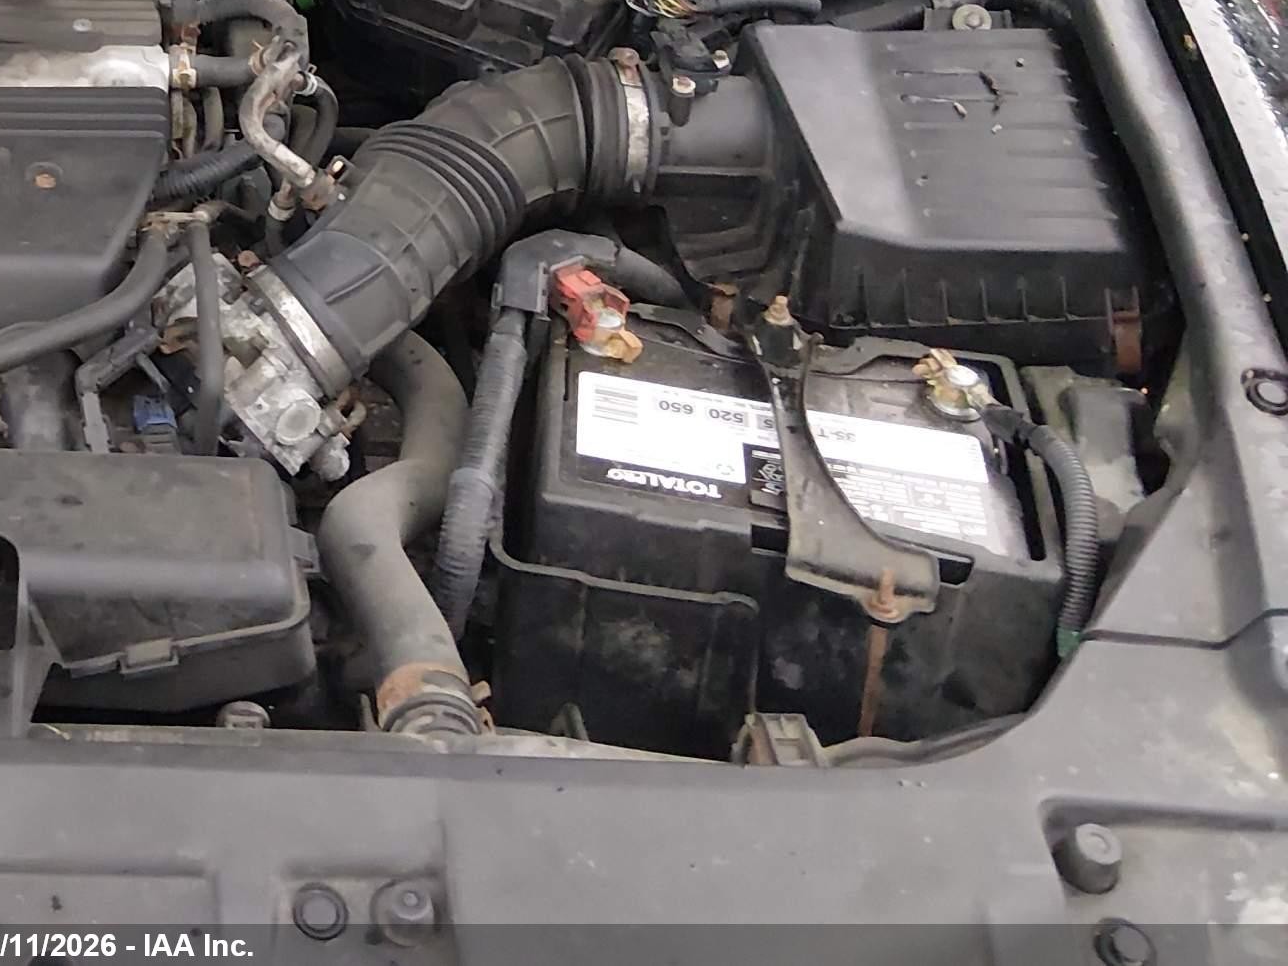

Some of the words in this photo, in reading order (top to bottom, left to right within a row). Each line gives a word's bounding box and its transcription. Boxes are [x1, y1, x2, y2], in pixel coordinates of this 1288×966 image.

[658, 400, 694, 415] 650
[708, 408, 744, 424] 520
[605, 467, 723, 499] TOTALPRO
